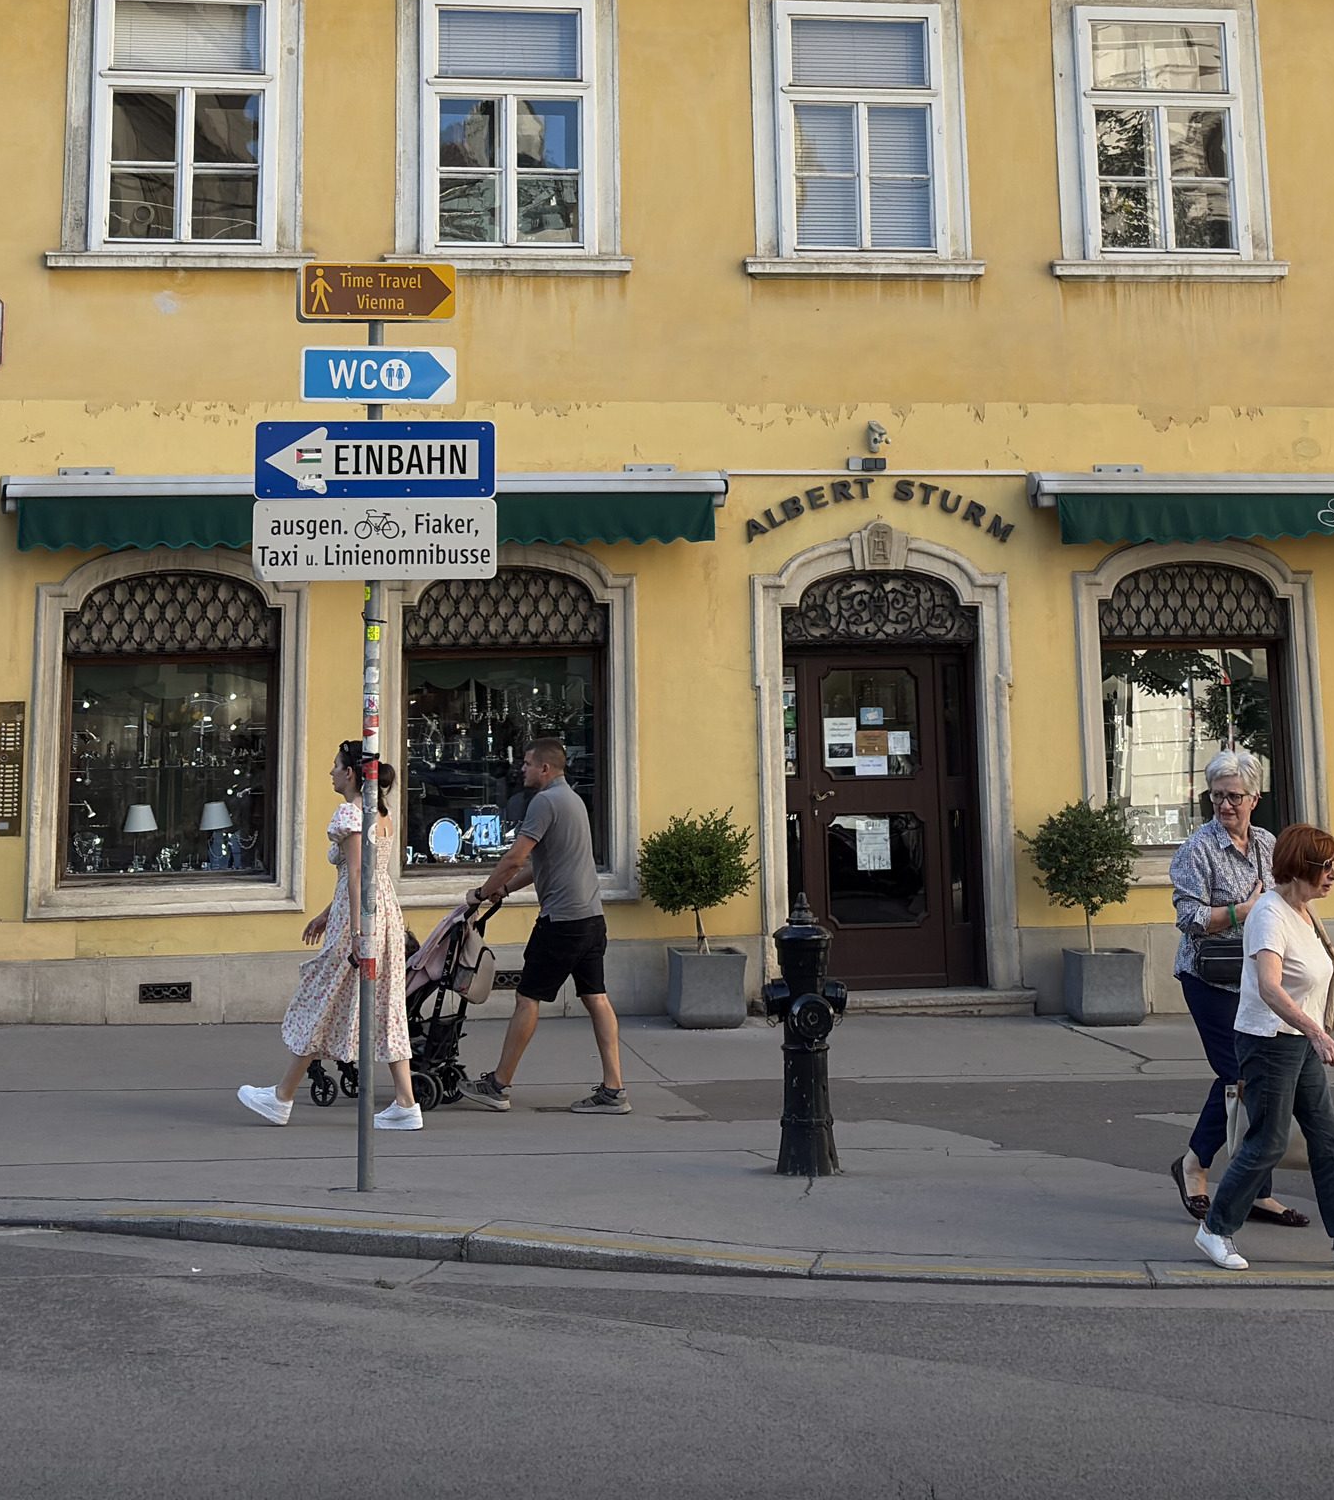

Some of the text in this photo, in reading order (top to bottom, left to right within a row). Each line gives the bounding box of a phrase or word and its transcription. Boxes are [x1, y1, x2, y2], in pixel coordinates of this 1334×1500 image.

[339, 271, 423, 290] Time Travel
[356, 294, 406, 311] Vienna
[327, 358, 378, 391] WC
[333, 443, 468, 476] EINBAHN
[745, 477, 1015, 544] ALBERT STURM
[270, 512, 480, 540] ausgen. Fiaker,
[257, 545, 491, 567] Taxi u. Linienomnibusse
